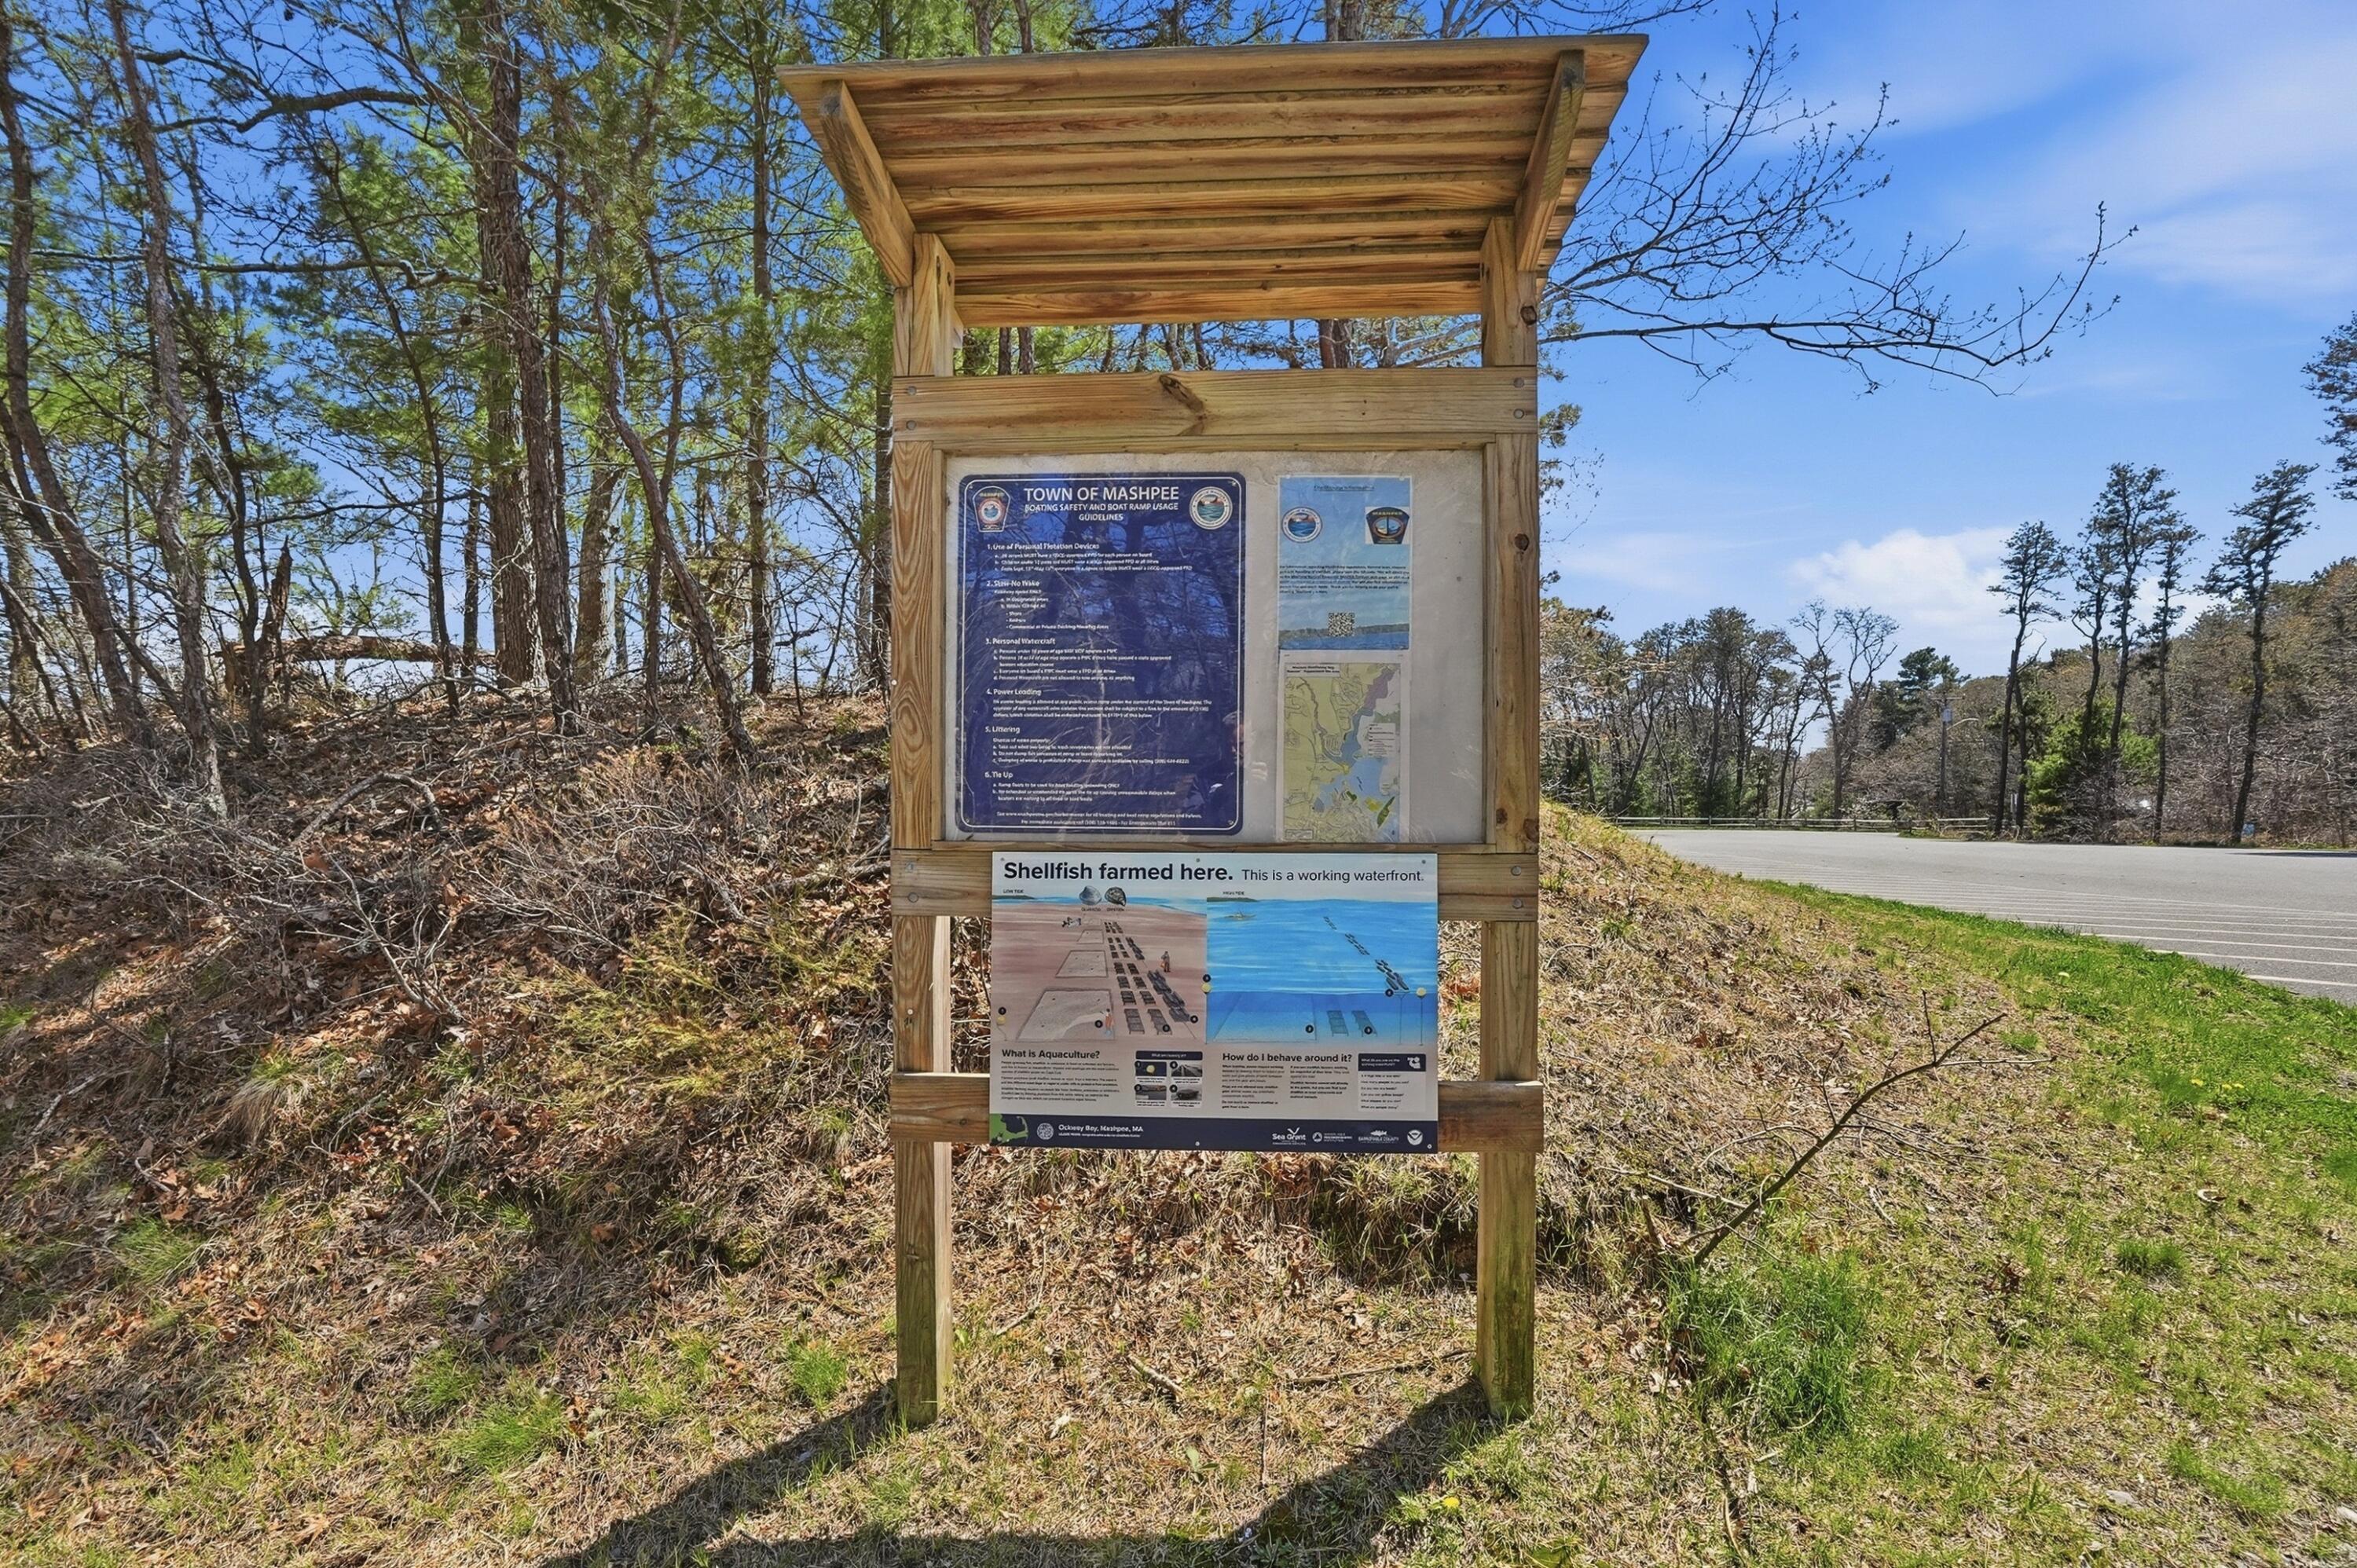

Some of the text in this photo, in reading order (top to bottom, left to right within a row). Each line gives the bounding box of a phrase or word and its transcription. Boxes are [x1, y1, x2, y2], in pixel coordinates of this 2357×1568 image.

[1024, 486, 1179, 501] TOWN OF MASHPEE
[1003, 863, 1424, 884] Shellfish farmed here. This is a working waterfront.
[1039, 1050, 1100, 1059] Aquaculture?
[1222, 1053, 1244, 1061] How
[1340, 1053, 1352, 1062] it?
